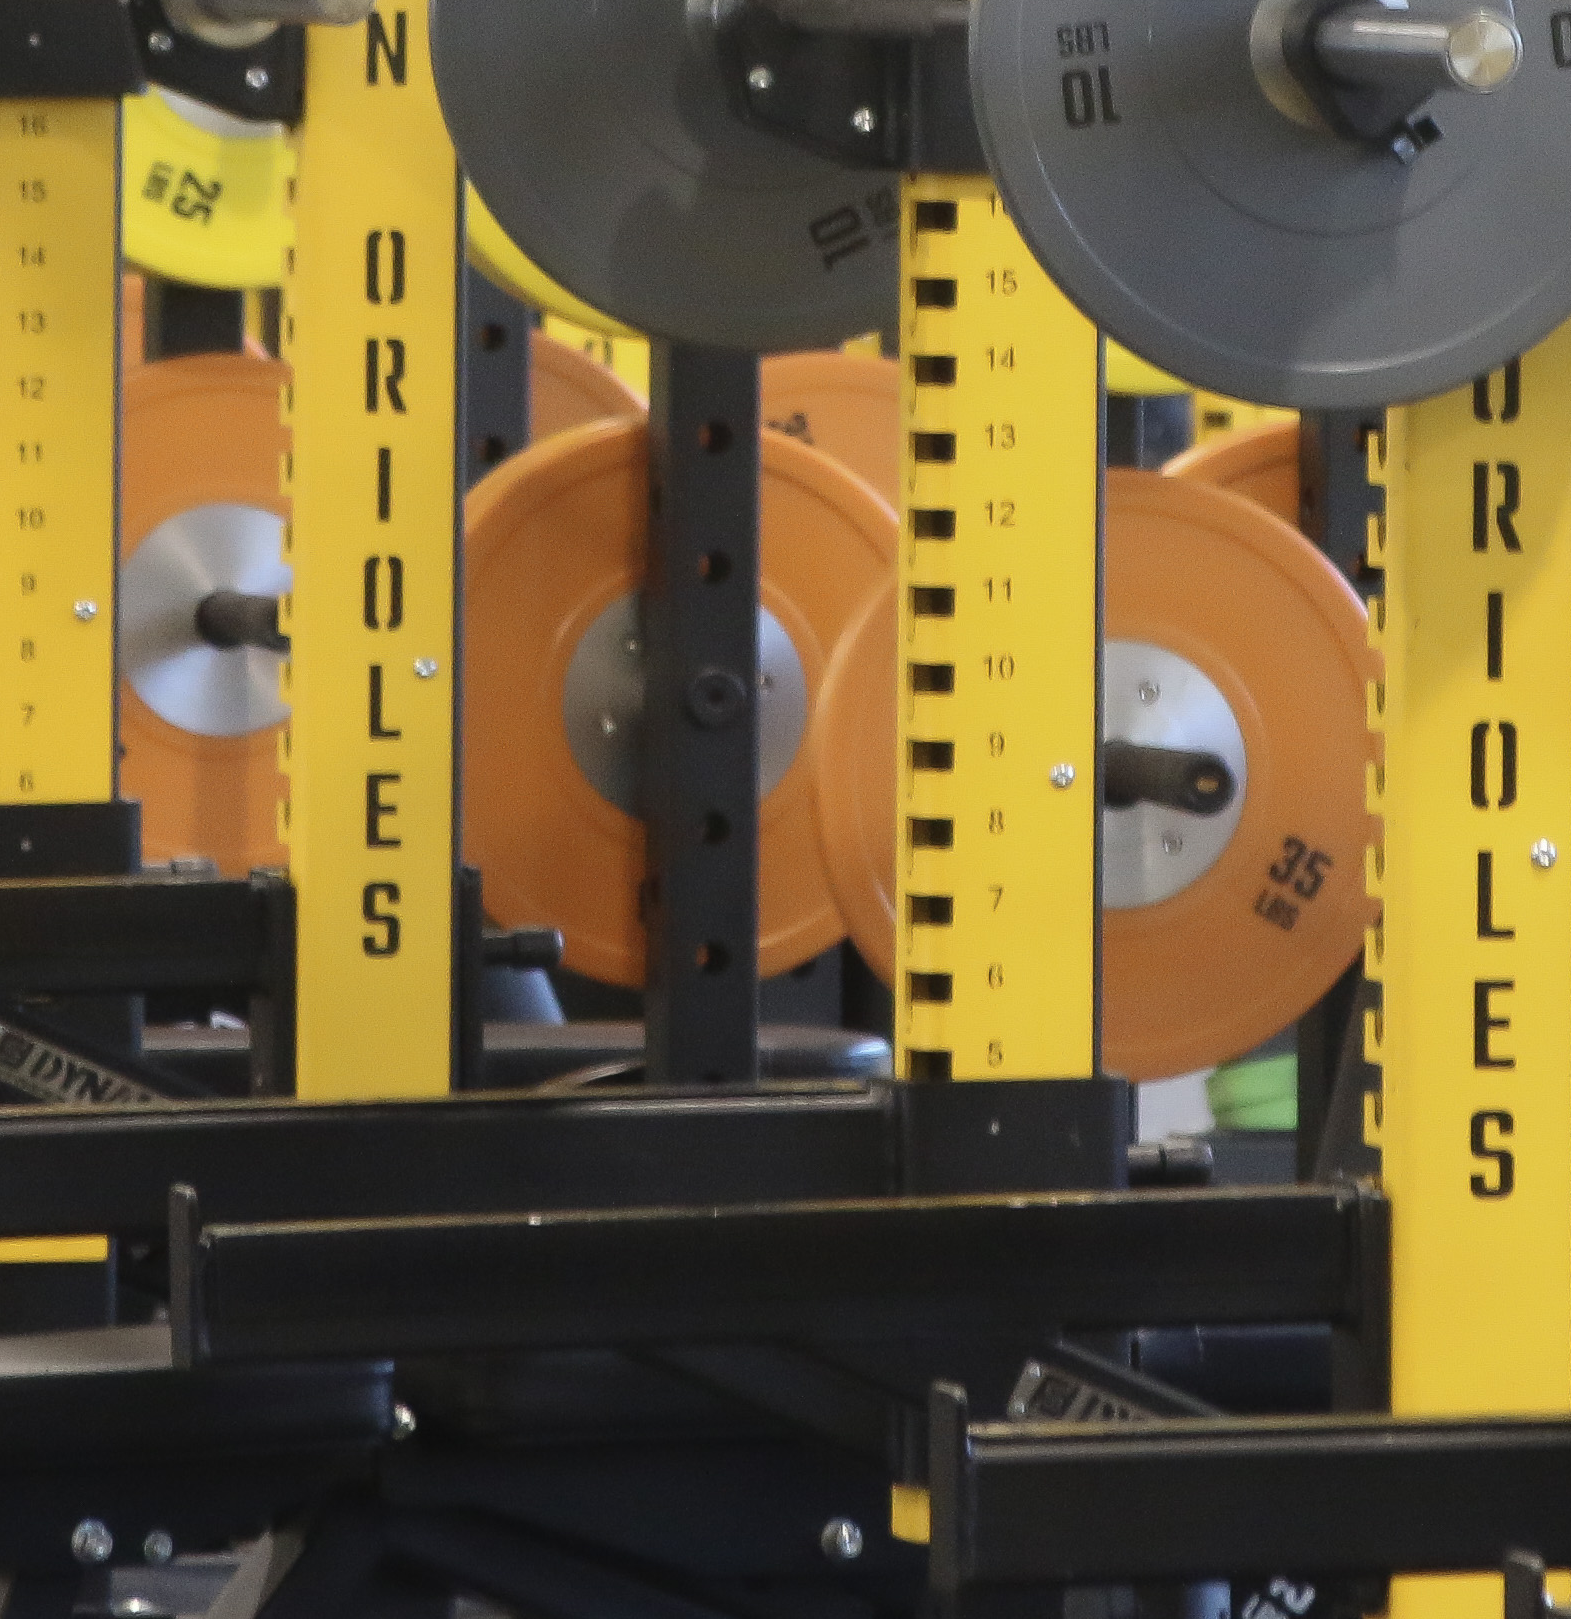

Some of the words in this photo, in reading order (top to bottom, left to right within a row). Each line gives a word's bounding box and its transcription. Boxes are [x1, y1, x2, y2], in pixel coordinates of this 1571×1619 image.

[1057, 21, 1111, 58] LBS
[1061, 68, 1122, 130] 10
[172, 170, 224, 226] 25
[988, 193, 1006, 218] 1
[808, 205, 870, 272] 10
[986, 346, 1016, 371] 14
[985, 424, 1016, 449] 13
[984, 502, 1015, 527] 12
[362, 230, 407, 957] ORIOLES
[983, 578, 1013, 603] 11
[983, 655, 1015, 680] 10
[1470, 356, 1522, 1201] ORIOLES
[1268, 835, 1333, 901] 35
[988, 886, 1004, 912] 7
